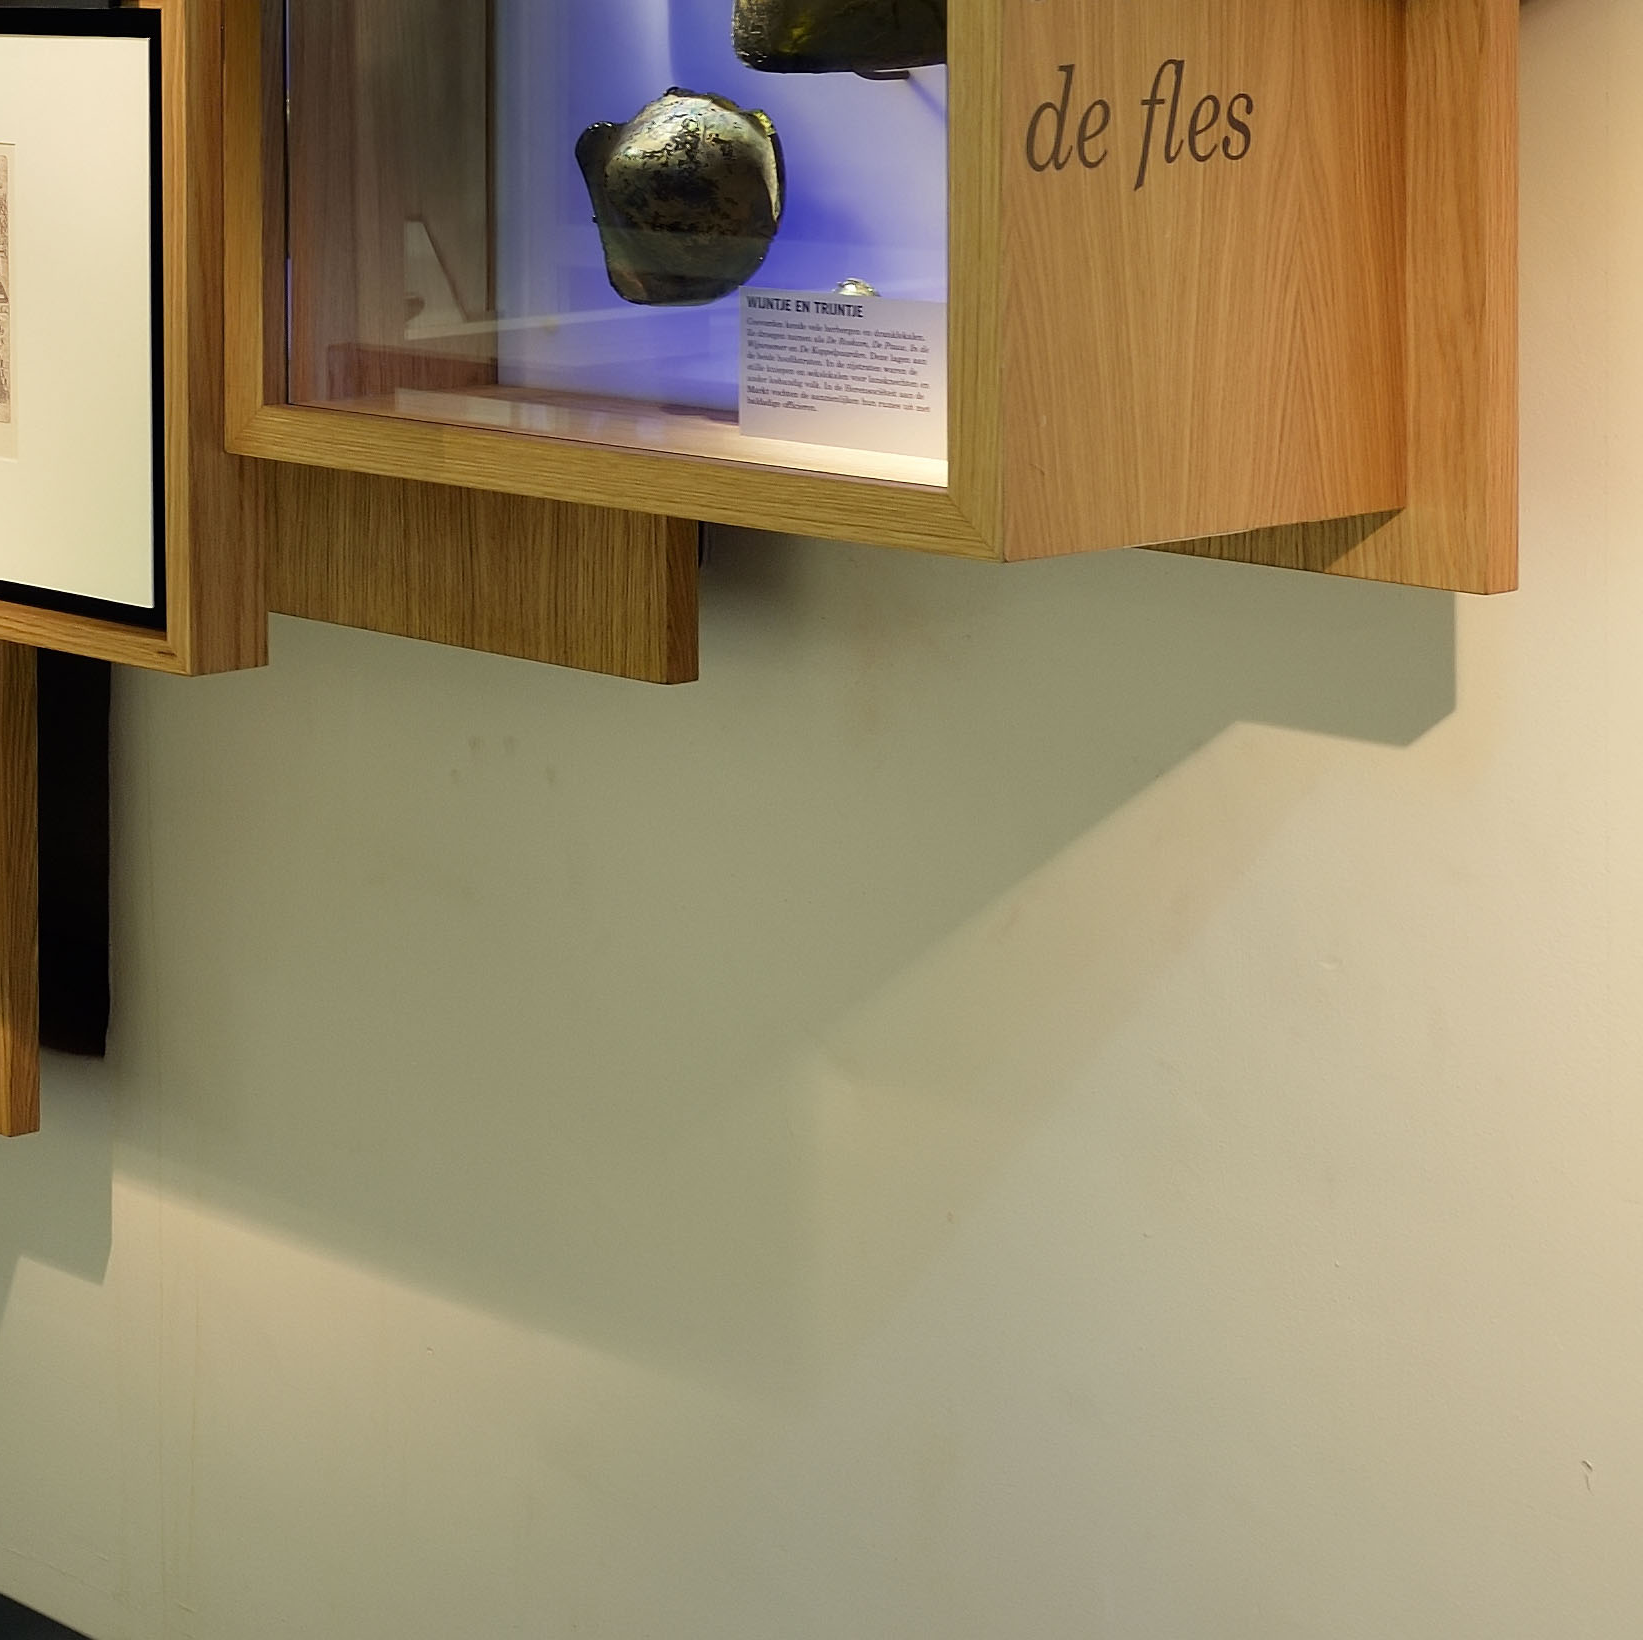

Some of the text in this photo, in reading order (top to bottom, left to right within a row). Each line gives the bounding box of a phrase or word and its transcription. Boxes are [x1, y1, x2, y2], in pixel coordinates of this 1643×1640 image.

[1026, 59, 1254, 191] de fles
[796, 300, 810, 313] EN
